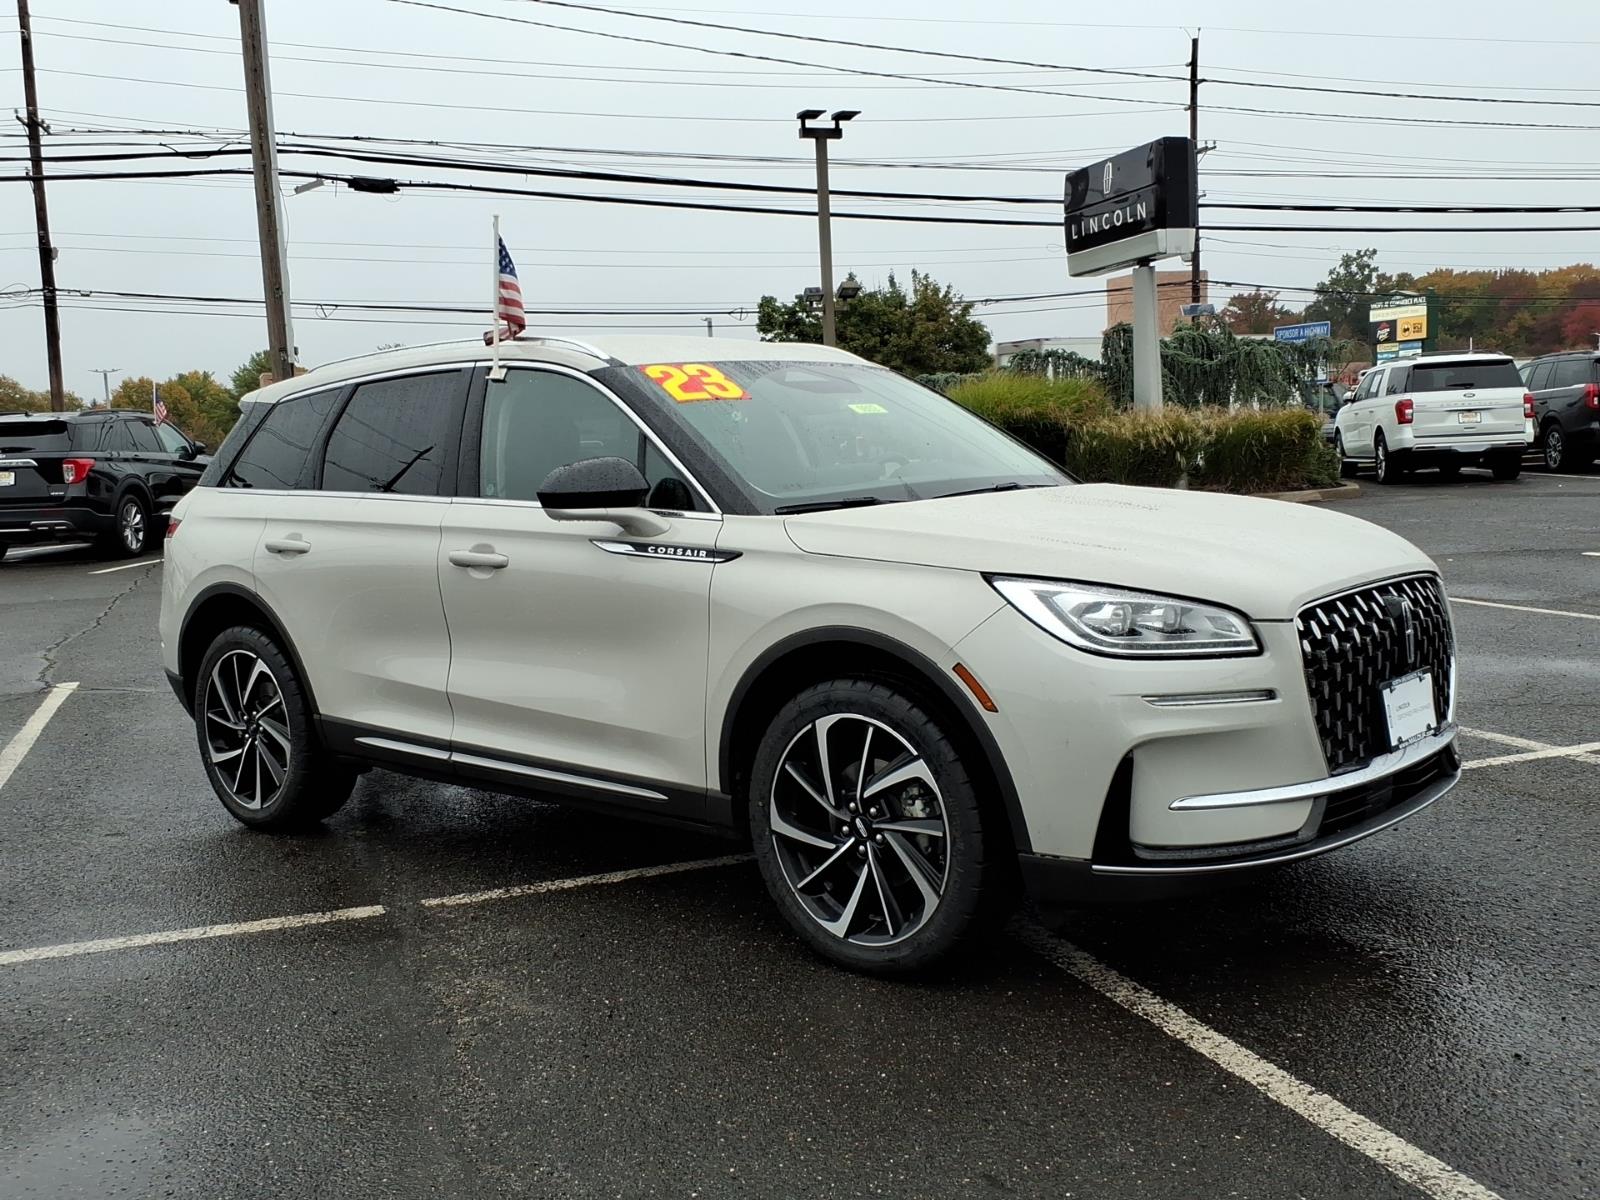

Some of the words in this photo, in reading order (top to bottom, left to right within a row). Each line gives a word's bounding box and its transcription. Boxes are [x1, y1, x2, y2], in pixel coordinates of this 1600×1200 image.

[1071, 202, 1147, 240] LINCOLN
[1276, 328, 1298, 339] SPONSOR
[1304, 325, 1328, 337] HIGHWAY
[645, 363, 744, 402] 23
[648, 545, 707, 558] CORSAIR
